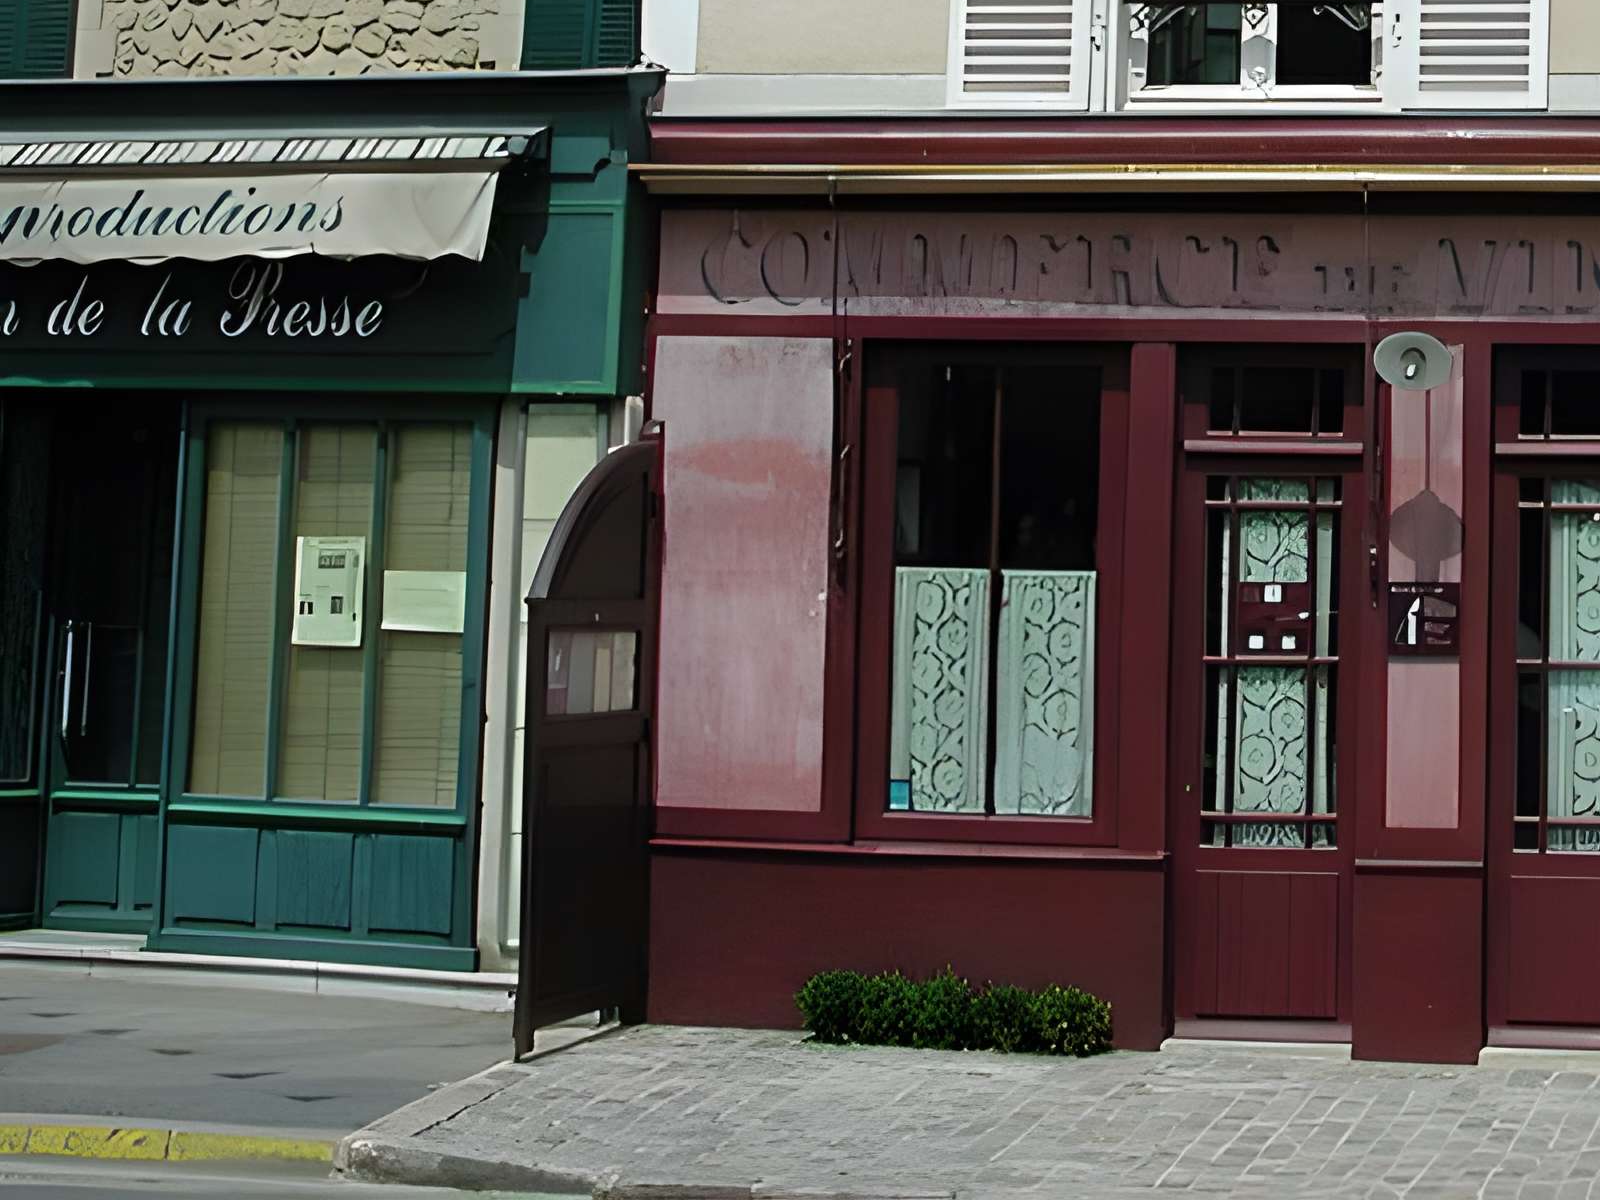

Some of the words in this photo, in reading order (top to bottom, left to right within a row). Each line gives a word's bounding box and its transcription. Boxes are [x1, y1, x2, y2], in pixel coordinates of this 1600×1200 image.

[47, 273, 105, 337] de
[141, 273, 192, 337] la
[219, 260, 384, 338] Presse
